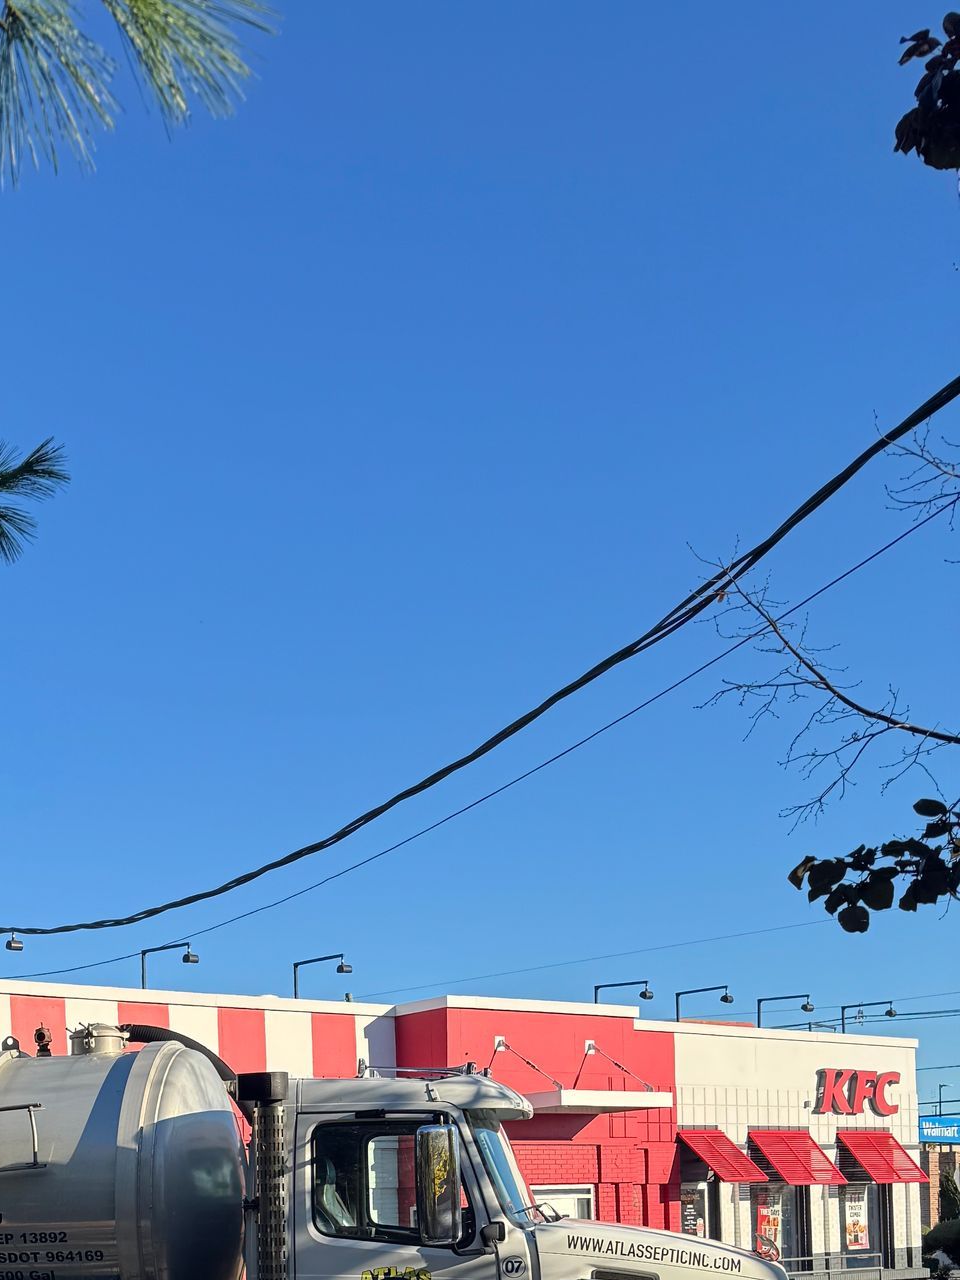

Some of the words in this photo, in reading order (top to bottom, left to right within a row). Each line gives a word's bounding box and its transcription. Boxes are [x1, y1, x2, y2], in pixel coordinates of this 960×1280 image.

[812, 1068, 901, 1116] KFC
[922, 1121, 959, 1138] Walmart
[19, 1231, 69, 1245] 13892
[44, 1250, 105, 1263] 964169
[567, 1234, 741, 1273] WWW.ATLASSEPTICINC.COM
[504, 1260, 523, 1274] 07
